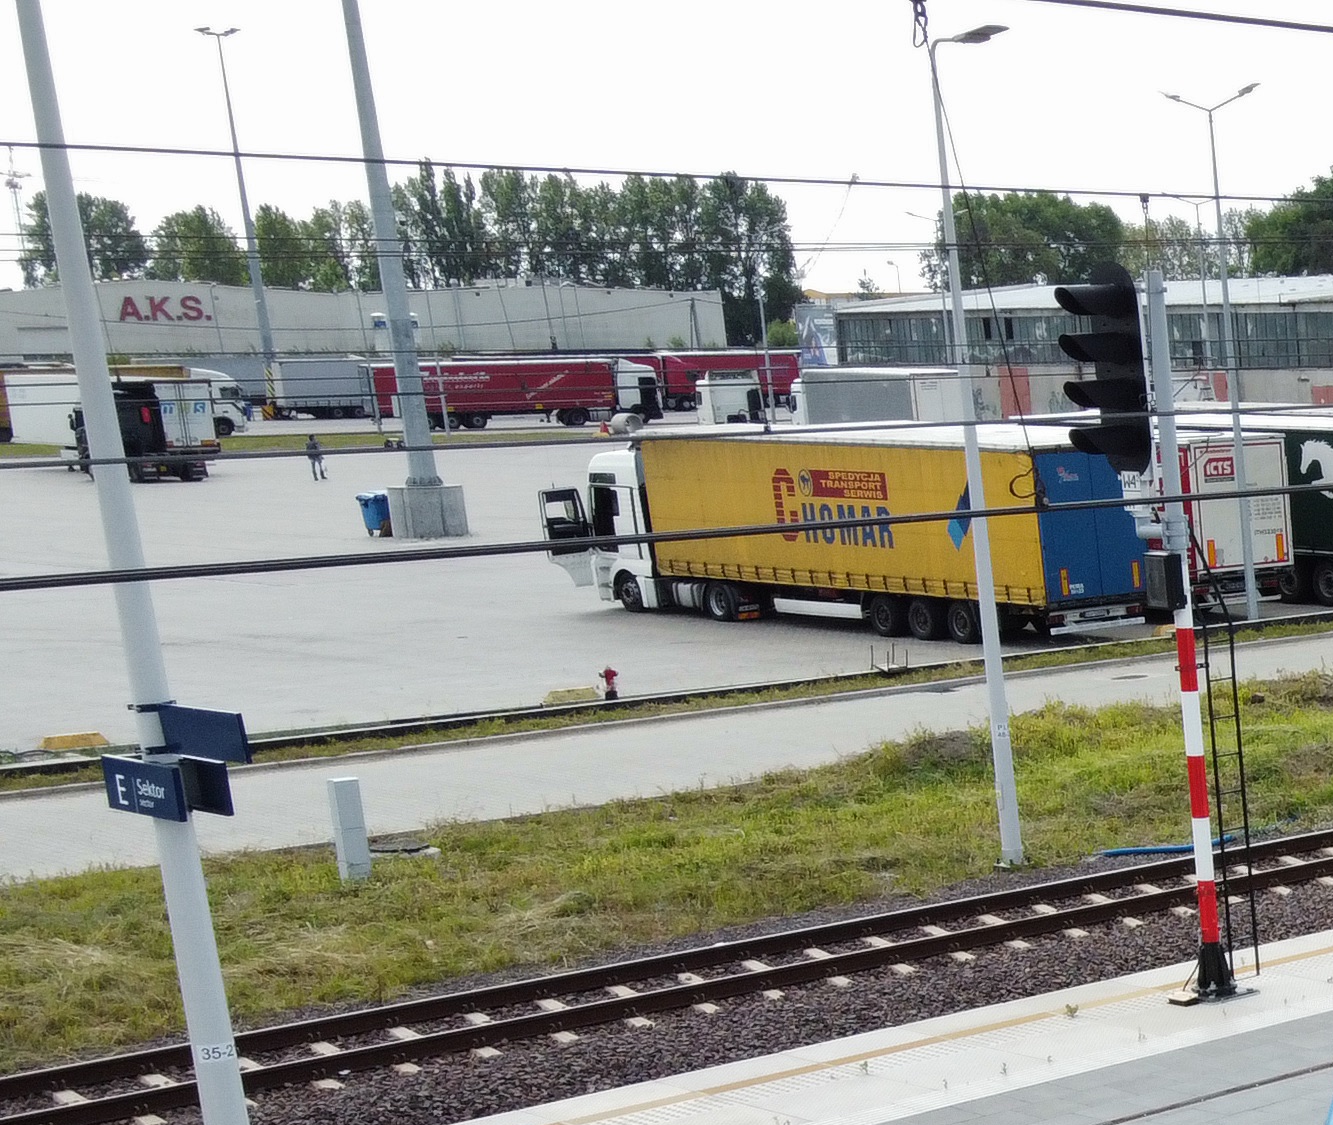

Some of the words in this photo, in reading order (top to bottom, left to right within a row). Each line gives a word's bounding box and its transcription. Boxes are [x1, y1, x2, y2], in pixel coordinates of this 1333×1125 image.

[120, 296, 212, 321] A.K.S.
[1206, 460, 1232, 475] ICTS
[828, 471, 881, 482] SPEDYCJA
[820, 480, 882, 490] TRANSPORT
[843, 489, 884, 499] SERWIS
[115, 774, 129, 806] E
[136, 778, 165, 800] Sektor
